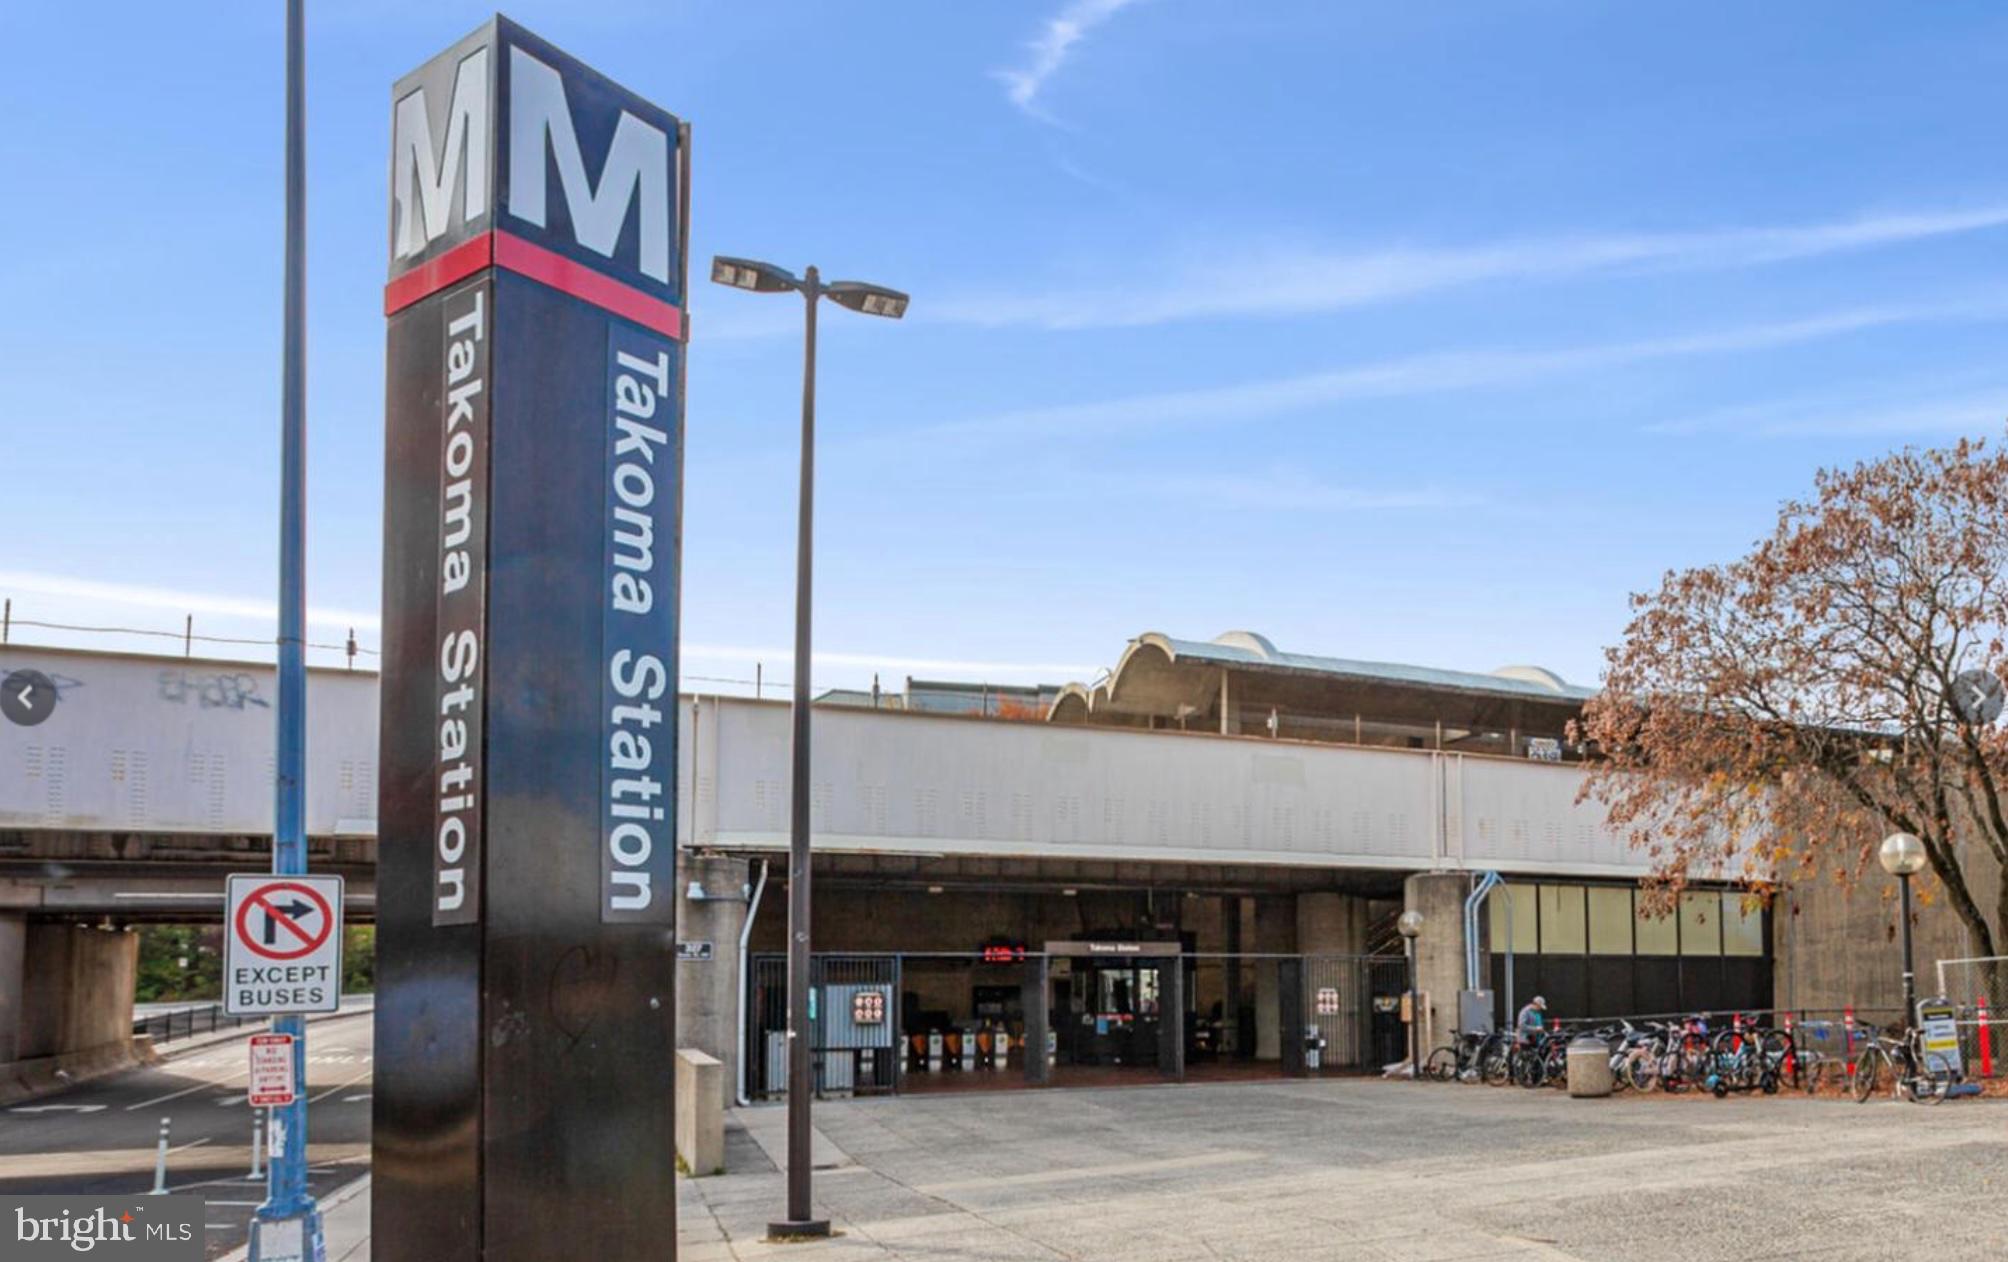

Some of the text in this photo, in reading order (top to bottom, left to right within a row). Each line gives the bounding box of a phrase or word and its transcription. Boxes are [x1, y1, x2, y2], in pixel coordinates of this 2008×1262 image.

[395, 46, 488, 260] M
[509, 44, 669, 285] M
[438, 291, 483, 911] Takoma Station
[610, 350, 669, 910] Takoma Station
[236, 965, 330, 984] EXCEPT
[240, 987, 323, 1006] BUSES
